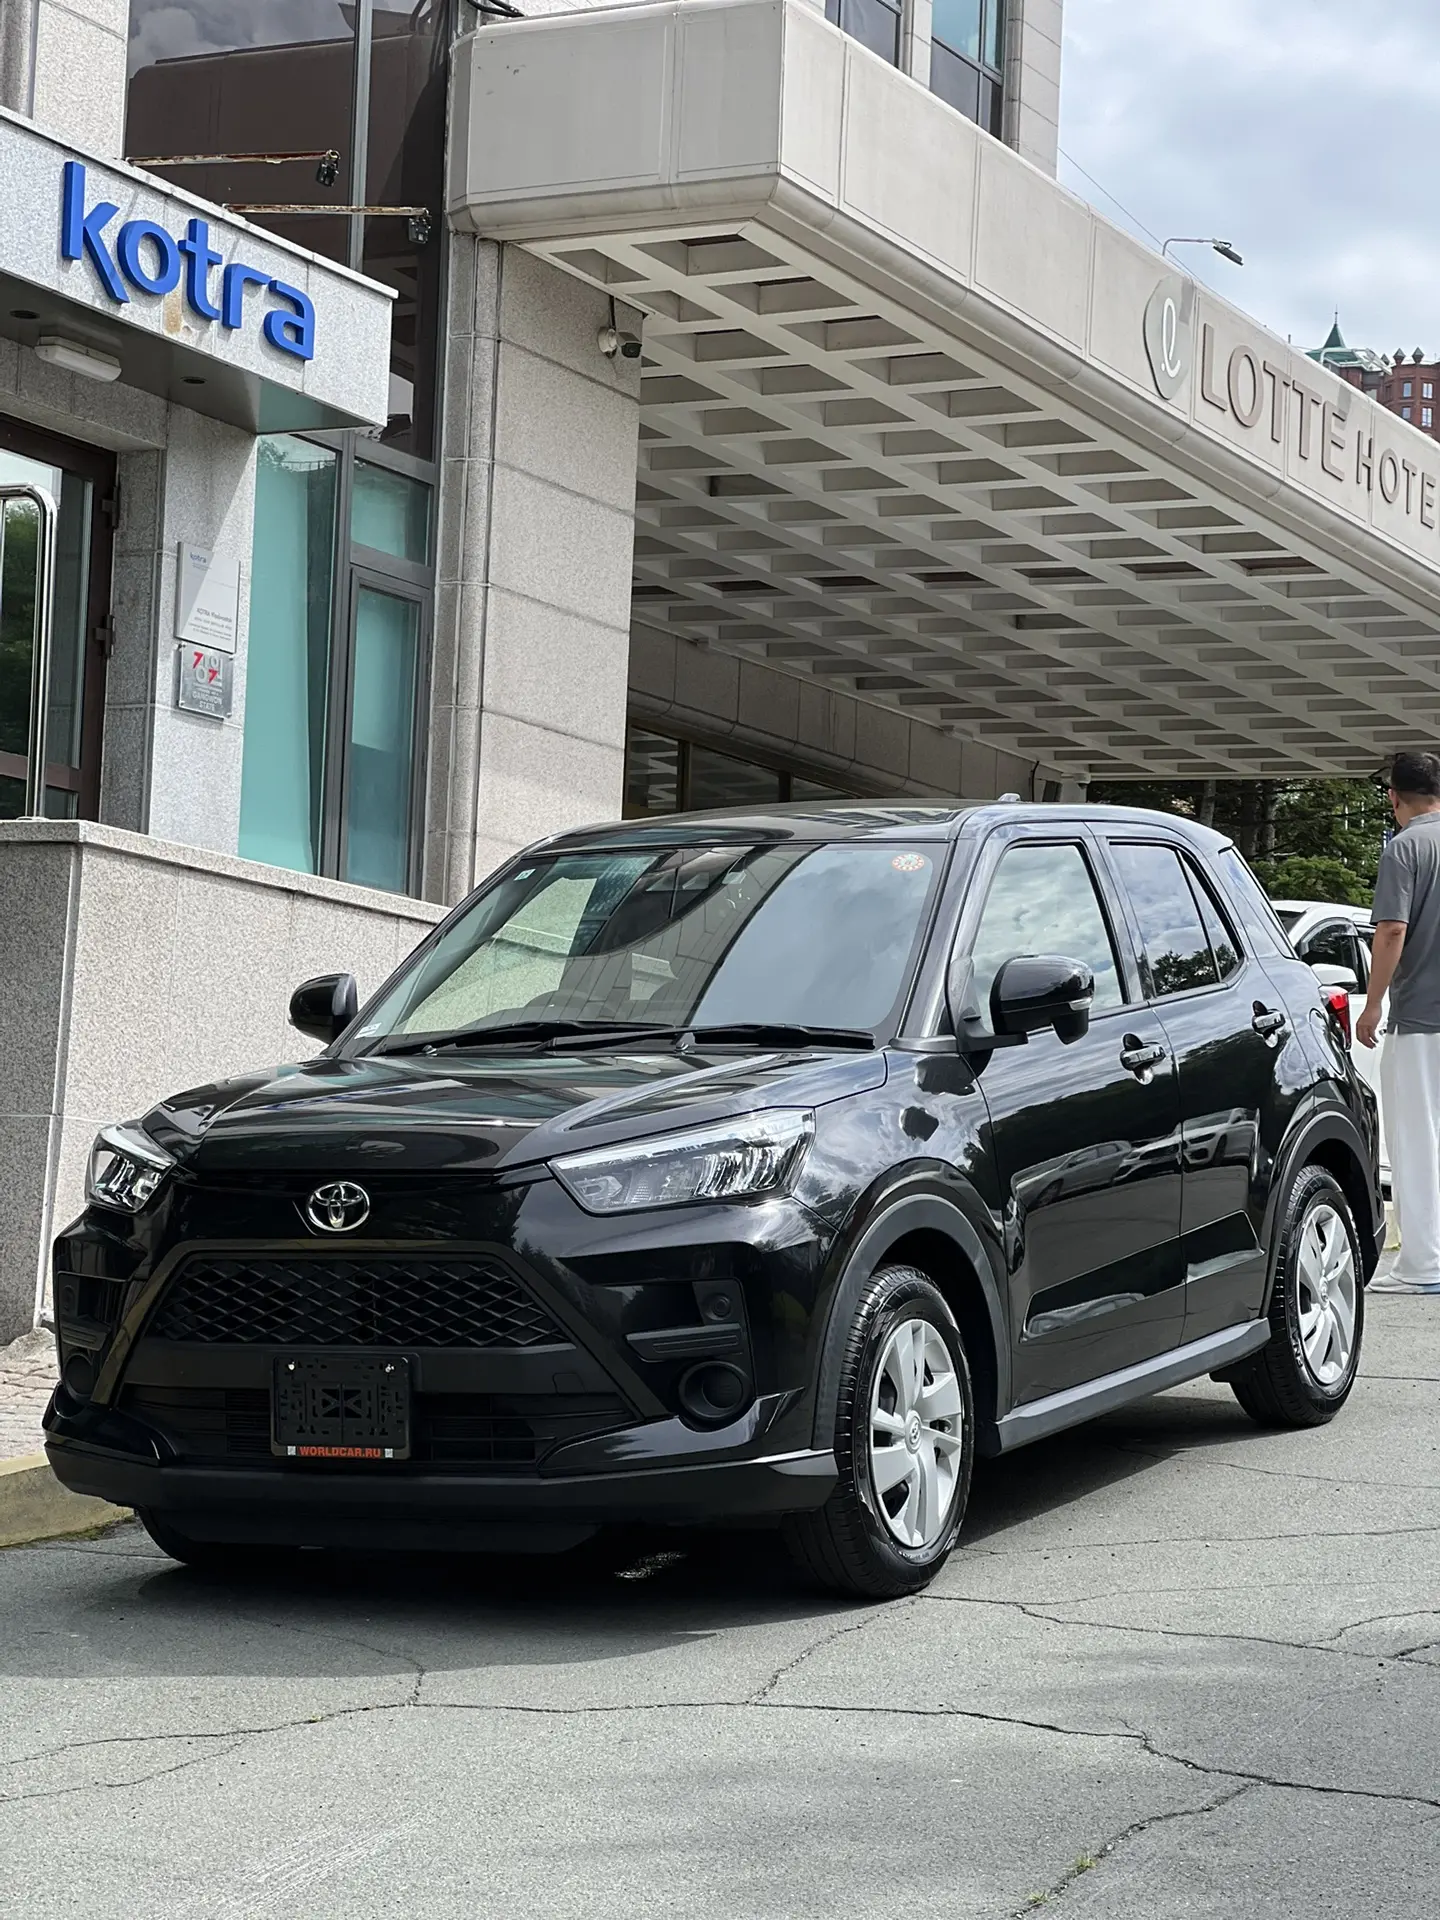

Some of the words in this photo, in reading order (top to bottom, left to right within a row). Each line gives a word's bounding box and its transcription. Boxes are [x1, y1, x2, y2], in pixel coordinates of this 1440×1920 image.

[62, 161, 315, 360] kotra
[1200, 322, 1349, 482] LOTTE
[1356, 430, 1440, 534] HOTE
[299, 1446, 381, 1458] WORLDCAR.RU
